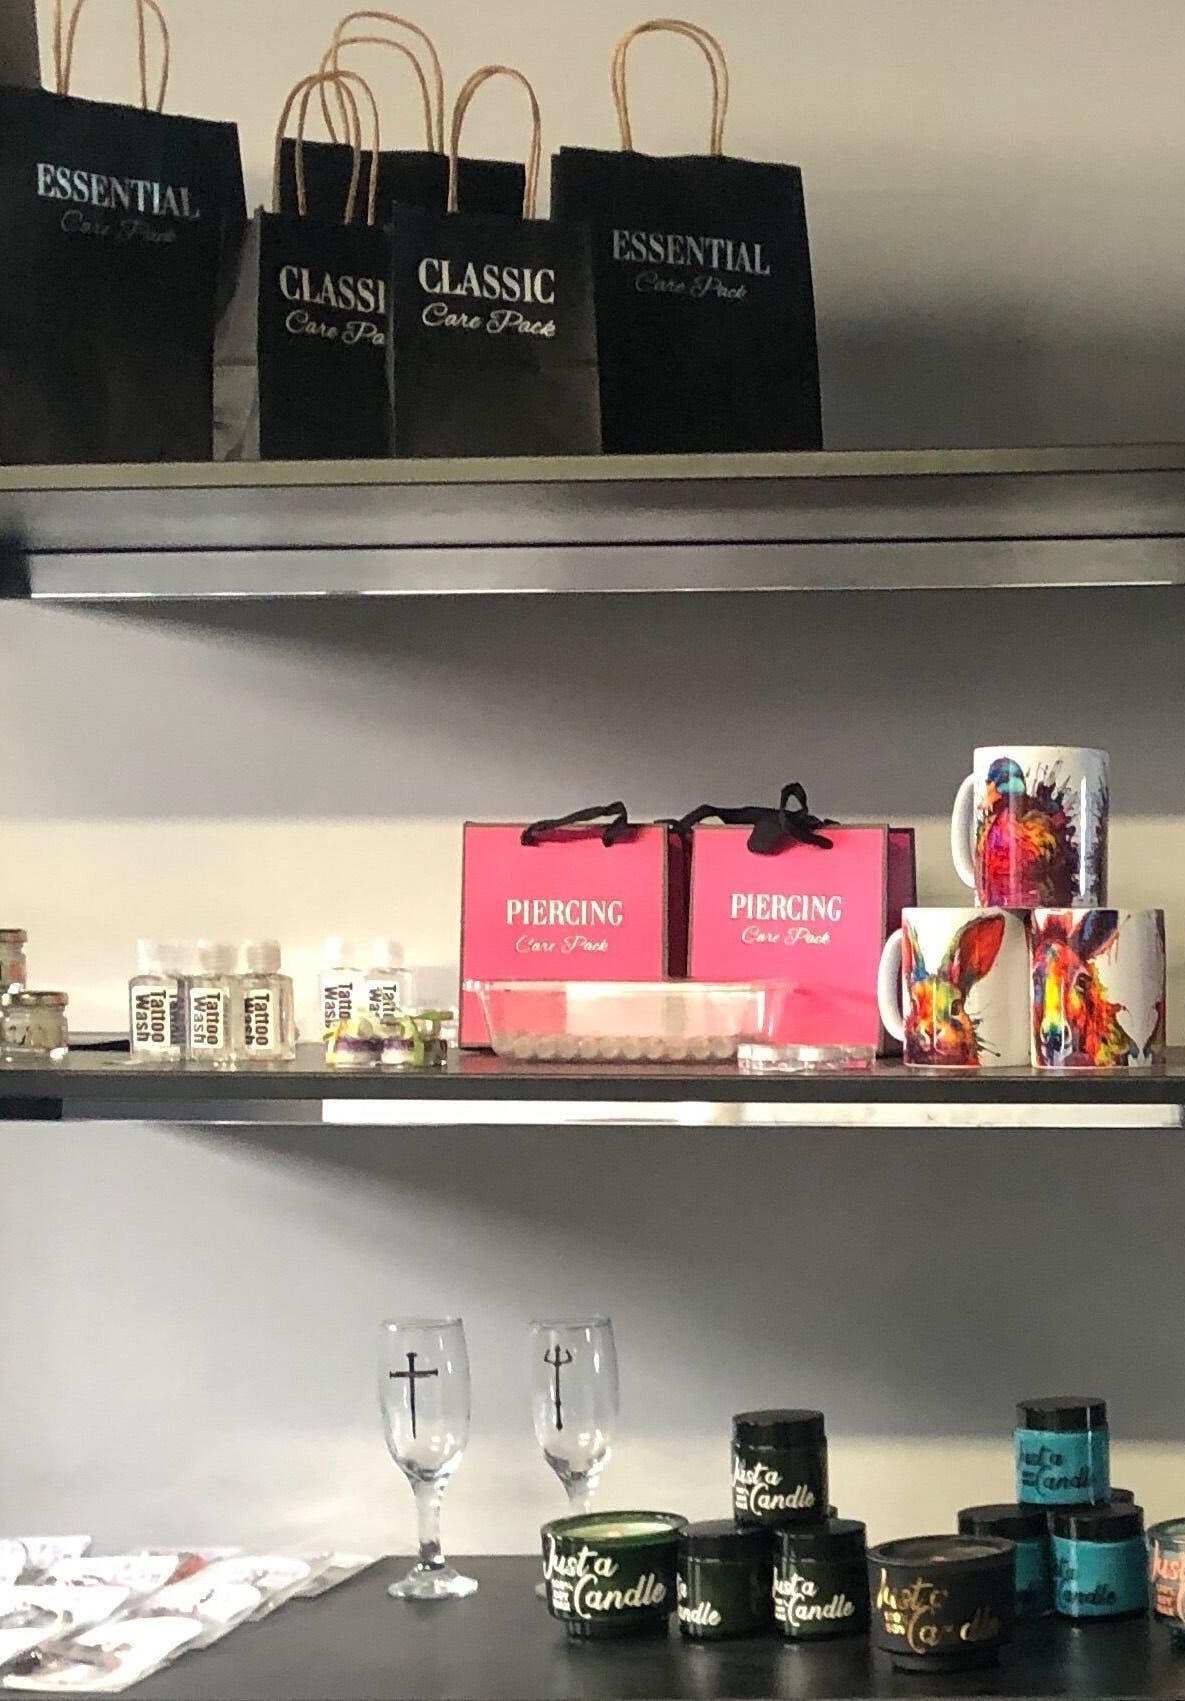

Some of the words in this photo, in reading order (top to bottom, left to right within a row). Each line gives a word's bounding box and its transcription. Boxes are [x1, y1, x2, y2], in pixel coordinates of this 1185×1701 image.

[36, 162, 201, 219] ESSENTIAL
[612, 229, 771, 276] ESSENTIAL
[418, 257, 555, 304] CLASSIC
[635, 271, 684, 297] Care
[689, 275, 748, 301] Pack
[285, 309, 338, 340] Care
[422, 302, 481, 331] Care
[486, 309, 556, 338] Pack
[505, 899, 624, 927] PIERCING
[730, 892, 843, 922] PIERCING
[515, 935, 556, 954] Care
[561, 936, 609, 954] Pack
[742, 926, 780, 945] Care
[784, 927, 832, 946] Pack
[135, 994, 150, 1042] Wash
[150, 989, 167, 1043] Tattoo
[193, 995, 206, 1044] Wash
[206, 992, 221, 1045] Tattoo
[254, 992, 270, 1046] Tattoo
[764, 1470, 783, 1487] a
[750, 1482, 817, 1516] Candle
[543, 1532, 598, 1580] Just
[593, 1556, 619, 1579] a
[574, 1572, 668, 1619] Candle
[801, 1580, 818, 1598] a
[788, 1592, 856, 1627] Candle
